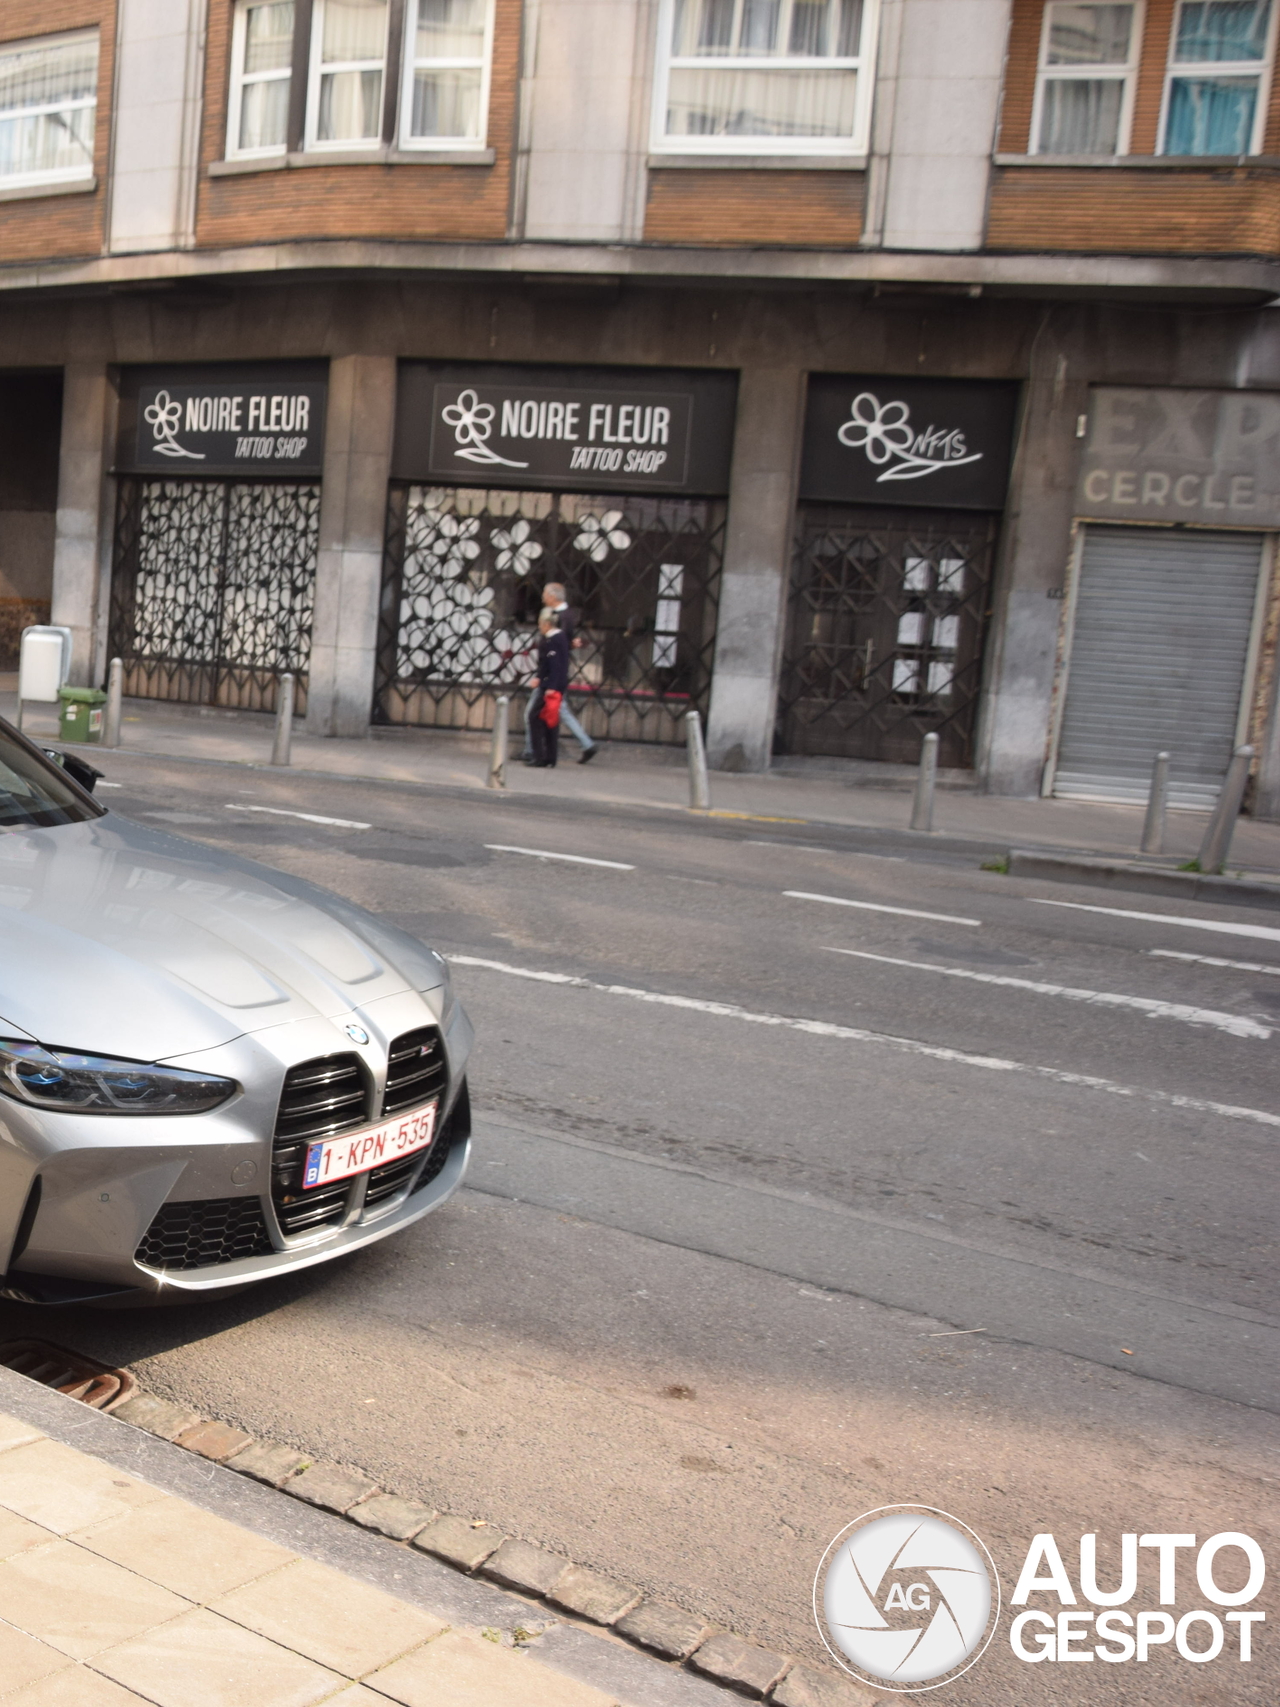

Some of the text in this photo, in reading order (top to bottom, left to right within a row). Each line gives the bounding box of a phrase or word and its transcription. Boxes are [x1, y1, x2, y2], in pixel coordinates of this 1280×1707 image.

[185, 395, 310, 432] NOIRE FLEUR
[500, 399, 671, 445] NOIRE FLEUR
[234, 436, 308, 459] TATTOO SHOP
[570, 446, 668, 474] TATTOO SHOP
[909, 424, 968, 460] NFTS
[1083, 468, 1257, 511] CERCLE
[307, 1113, 431, 1182] B 1-KPN-535
